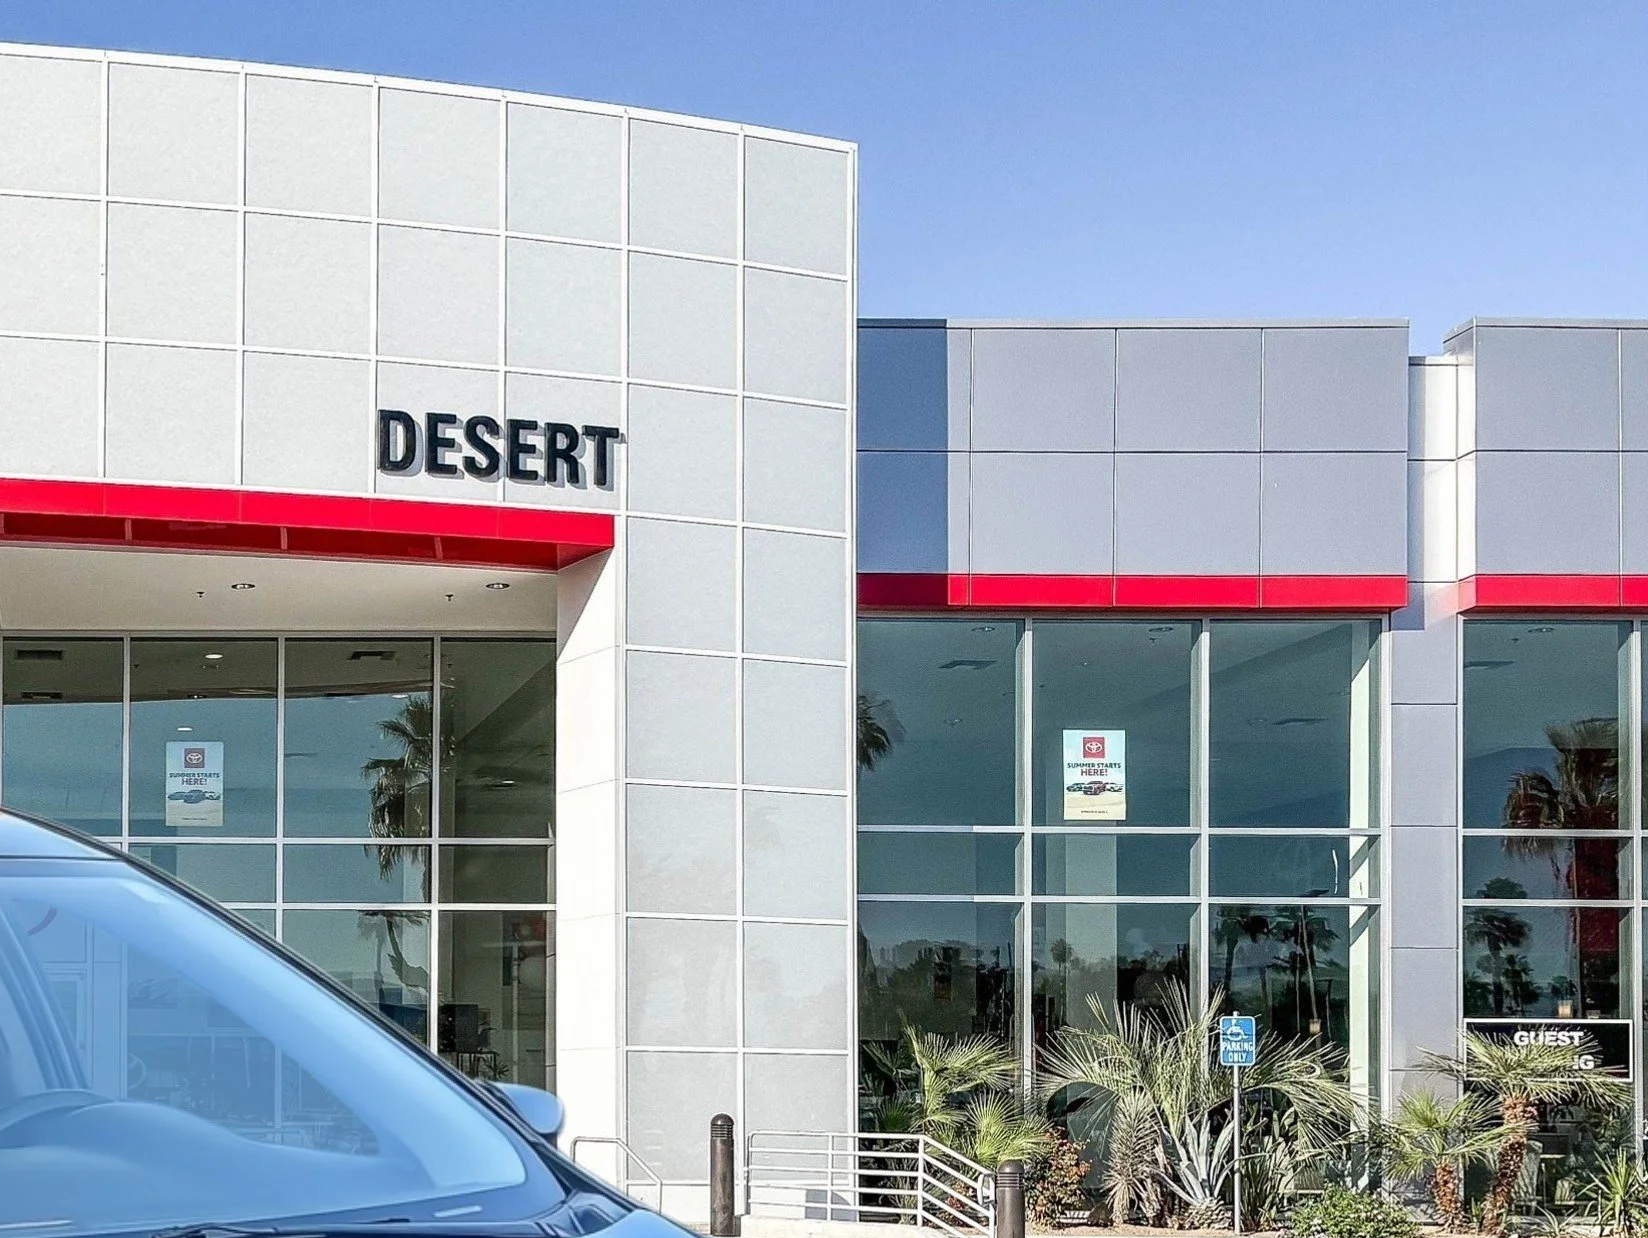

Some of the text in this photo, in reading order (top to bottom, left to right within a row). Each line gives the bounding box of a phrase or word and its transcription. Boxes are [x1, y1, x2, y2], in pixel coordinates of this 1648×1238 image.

[377, 409, 620, 487] DESERT
[1080, 768, 1108, 777] HERE!
[181, 778, 208, 786] HERE!
[1513, 1030, 1585, 1047] GUEST
[1222, 1041, 1254, 1052] PARKING
[1228, 1052, 1248, 1063] ONLY
